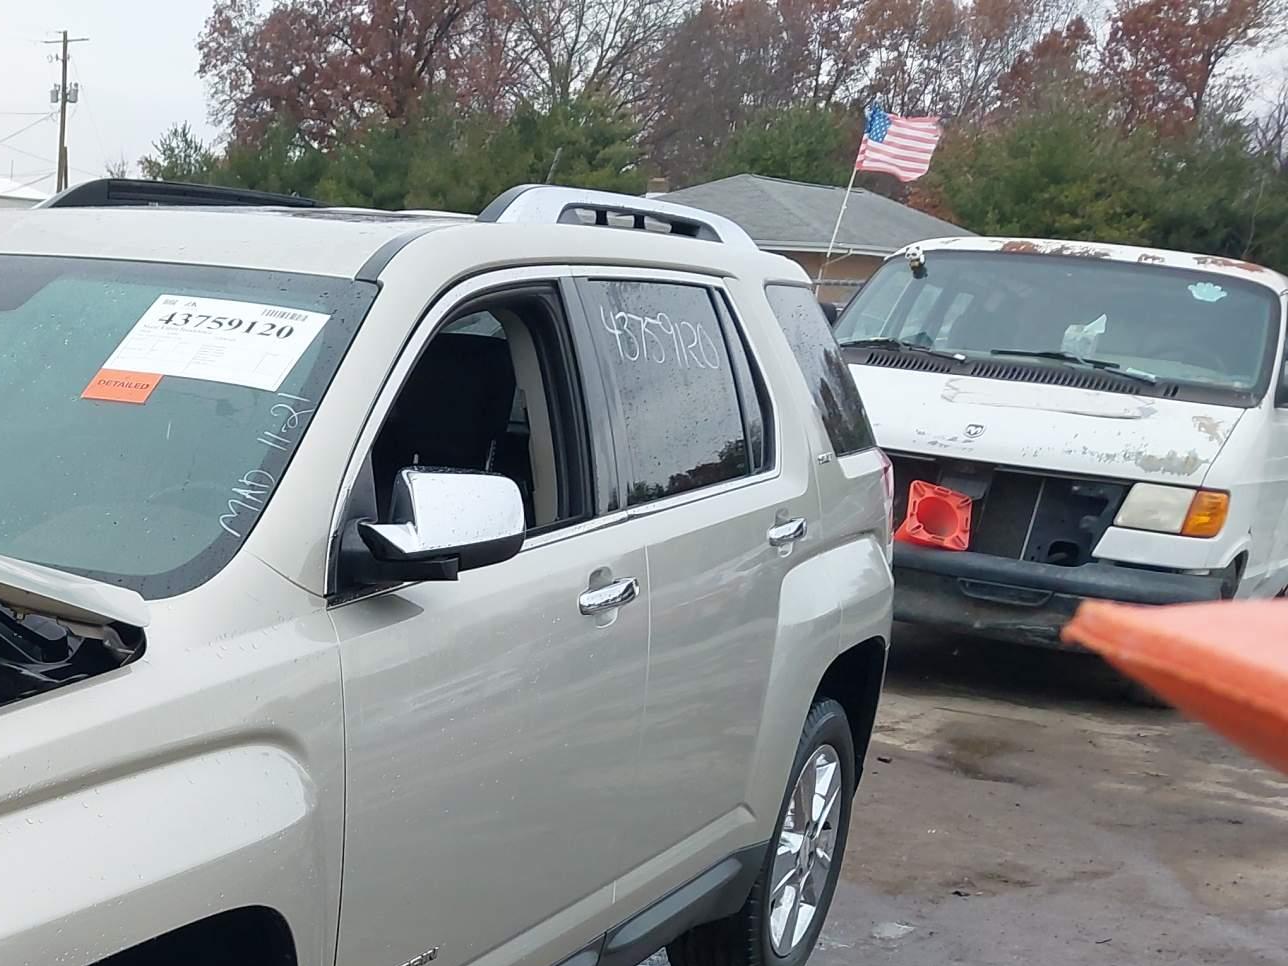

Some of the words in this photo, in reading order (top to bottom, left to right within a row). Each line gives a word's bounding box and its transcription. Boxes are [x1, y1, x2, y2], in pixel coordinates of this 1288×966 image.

[158, 311, 294, 340] 43759120
[97, 379, 150, 390] DETAILED
[219, 469, 276, 537] MAD
